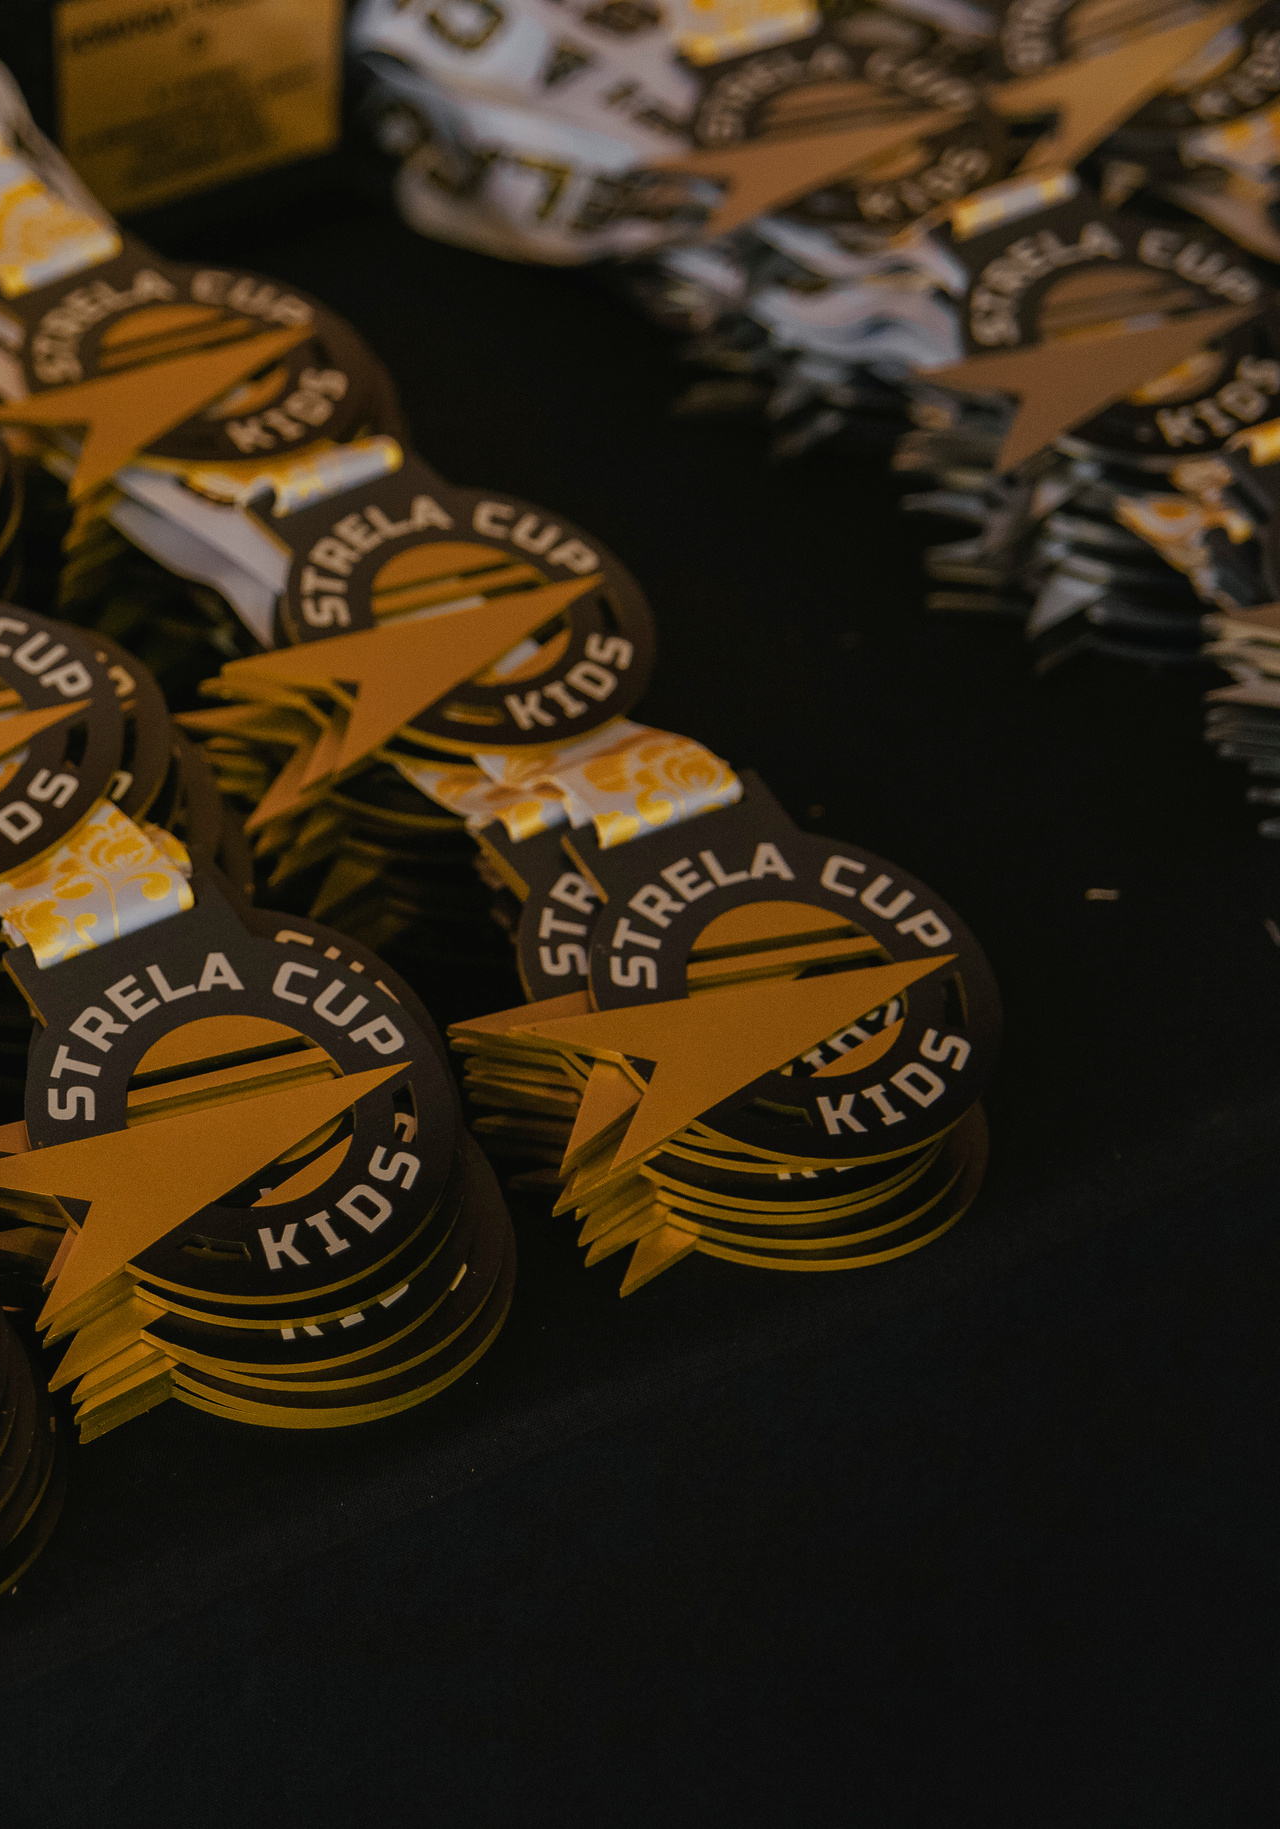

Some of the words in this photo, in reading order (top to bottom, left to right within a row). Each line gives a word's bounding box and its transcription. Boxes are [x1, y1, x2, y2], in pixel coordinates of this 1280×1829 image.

[31, 268, 177, 385] STRELA
[190, 268, 314, 326] CUP
[224, 365, 349, 454] KIDS
[301, 494, 456, 629] STRELA
[472, 500, 600, 576] CUP
[503, 632, 634, 731] KIDS
[609, 842, 796, 990] STRELA
[820, 854, 953, 948] CUP
[47, 951, 245, 1122] STRELA
[271, 961, 405, 1055] CUP
[815, 1028, 972, 1136] KIDS
[258, 1145, 422, 1270] KIDS
